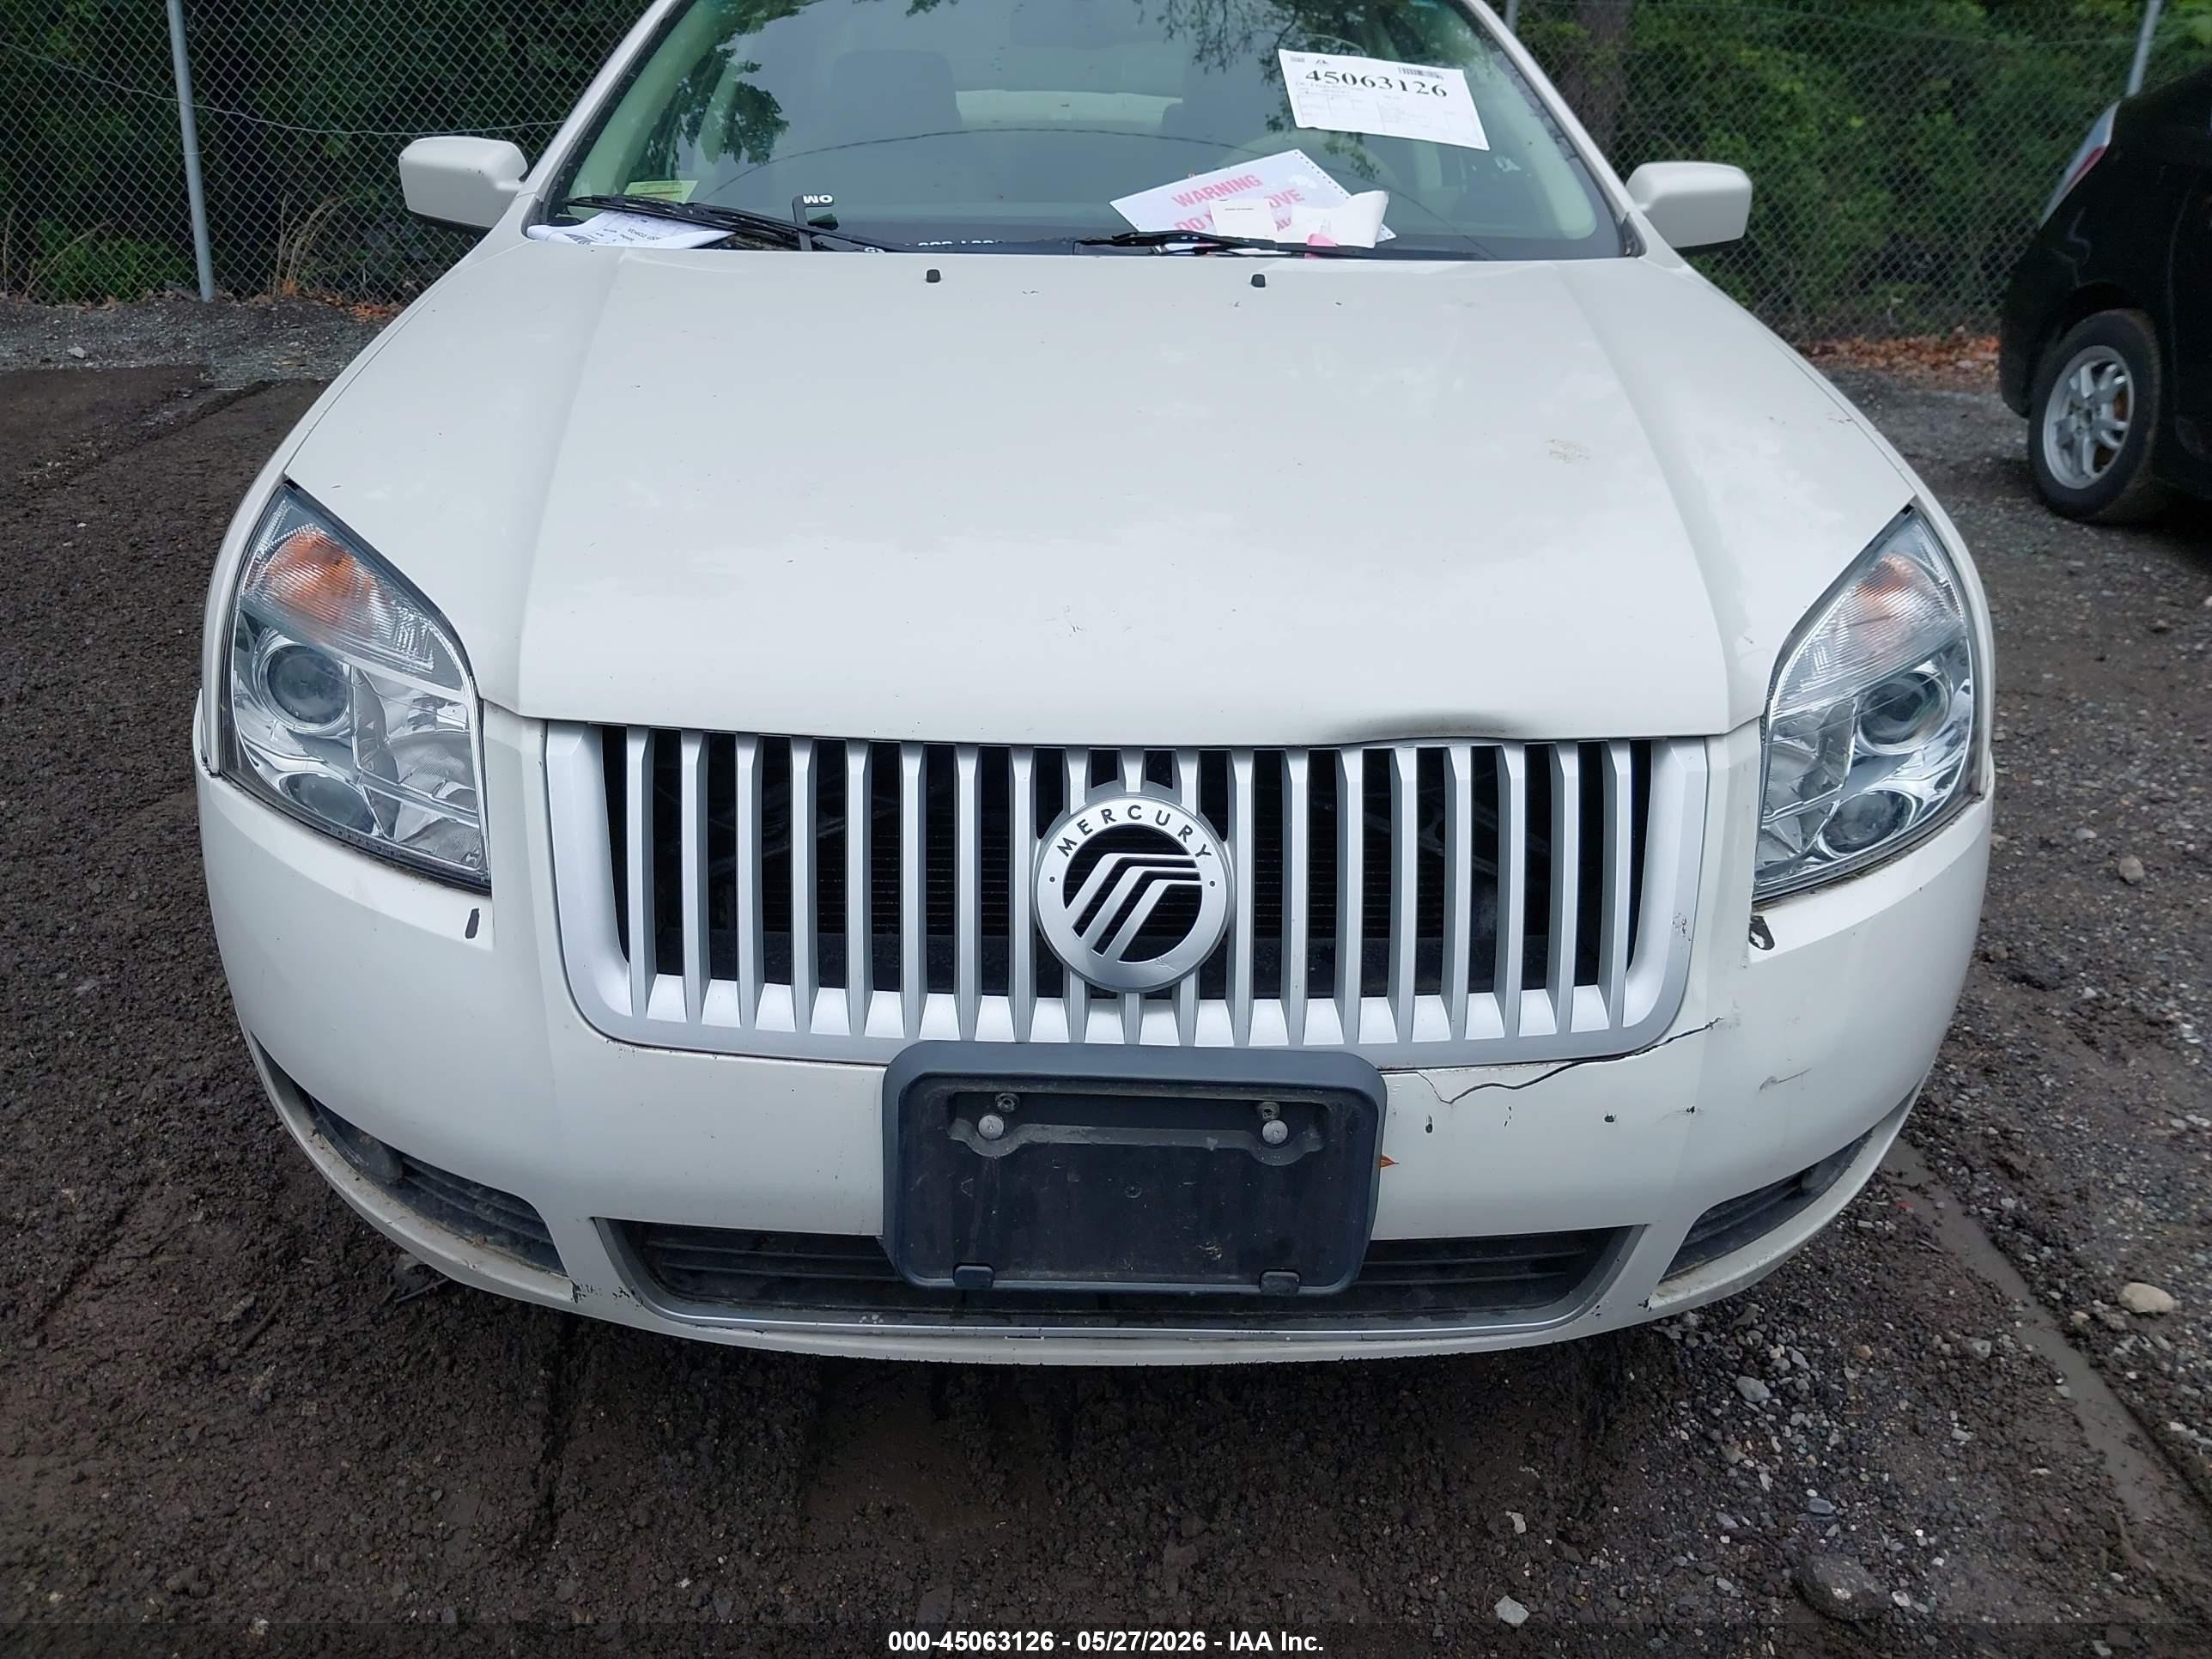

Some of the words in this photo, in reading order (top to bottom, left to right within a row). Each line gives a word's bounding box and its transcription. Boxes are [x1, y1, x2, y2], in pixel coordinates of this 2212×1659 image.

[1304, 69, 1449, 98] 45063126
[1171, 174, 1263, 208] WARNING
[1057, 805, 1212, 858] MERCURY
